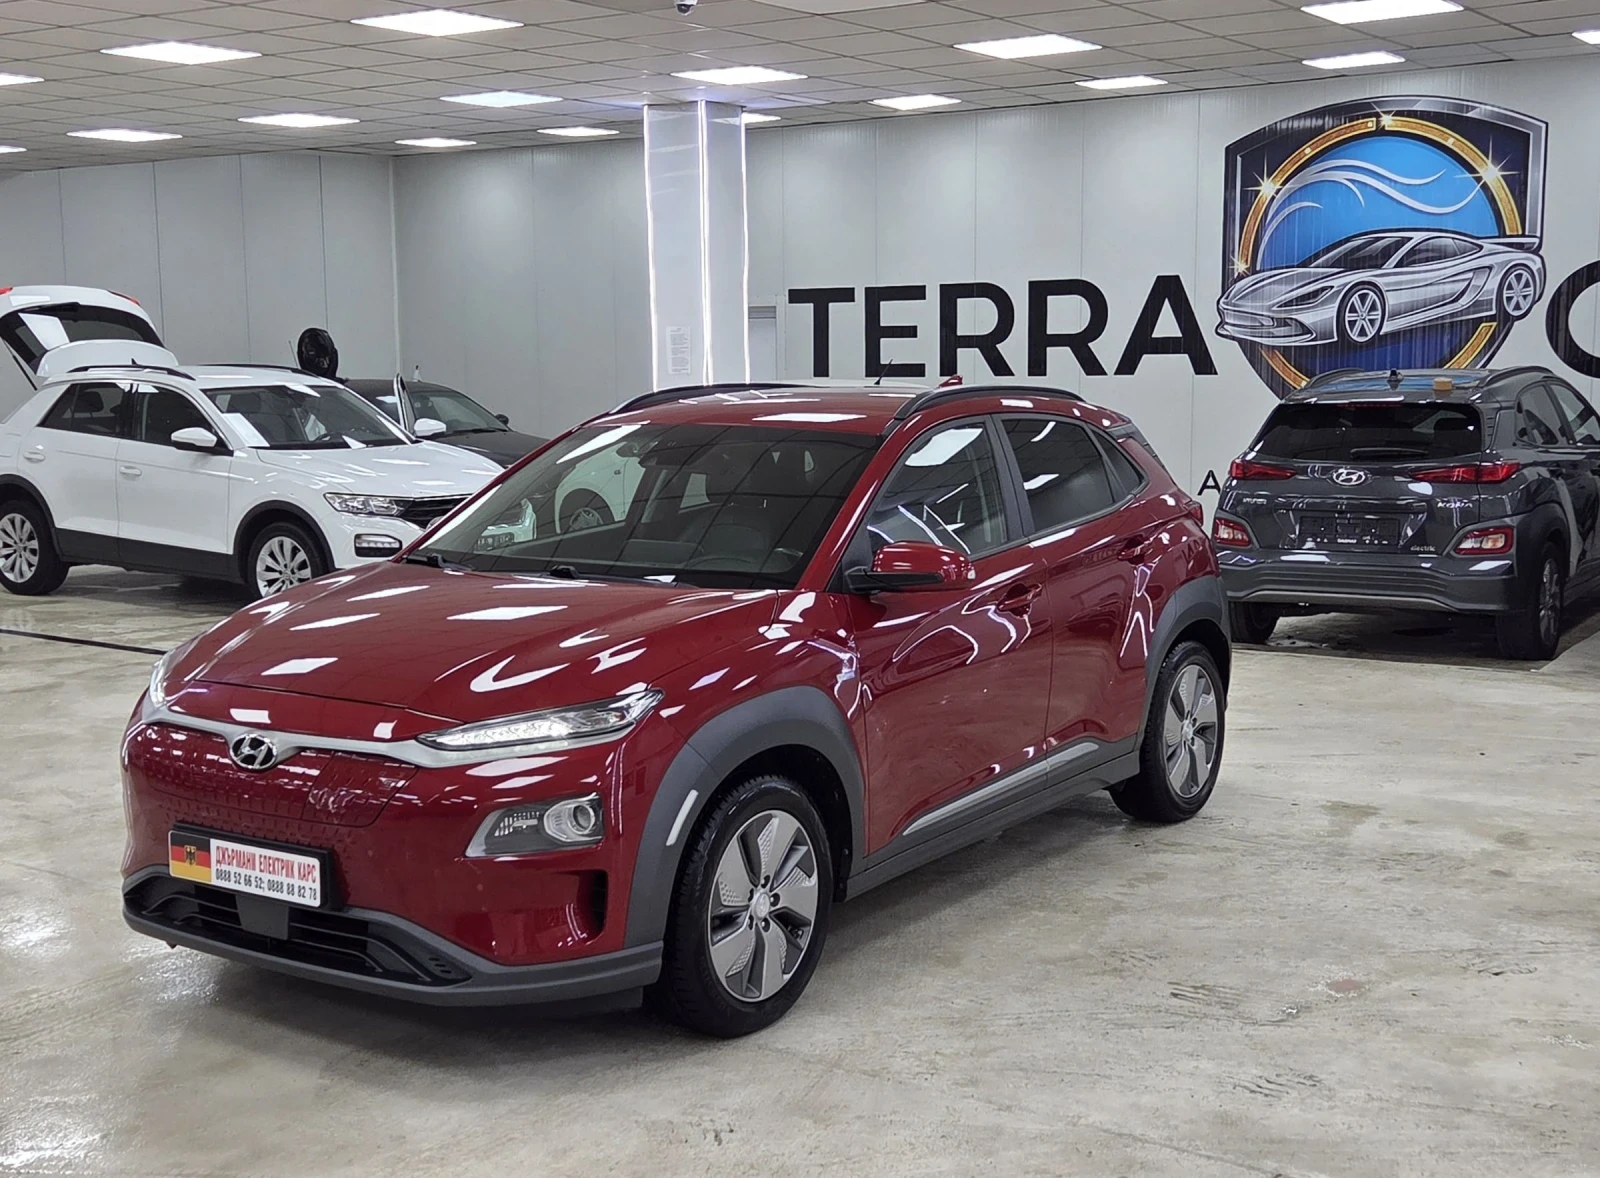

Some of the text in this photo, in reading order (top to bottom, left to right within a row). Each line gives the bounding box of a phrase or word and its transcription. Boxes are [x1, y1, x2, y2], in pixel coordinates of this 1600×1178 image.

[787, 274, 1219, 378] TERRA
[1410, 544, 1436, 552] electric
[259, 854, 295, 879] ЕЛЕКТРИК
[297, 861, 316, 883] КАРС
[216, 868, 231, 882] 0888
[233, 871, 242, 885] 52
[243, 873, 253, 887] 66
[267, 879, 284, 894] 0888
[286, 882, 295, 896] 88
[297, 885, 306, 898] 82
[308, 887, 317, 901] 78
